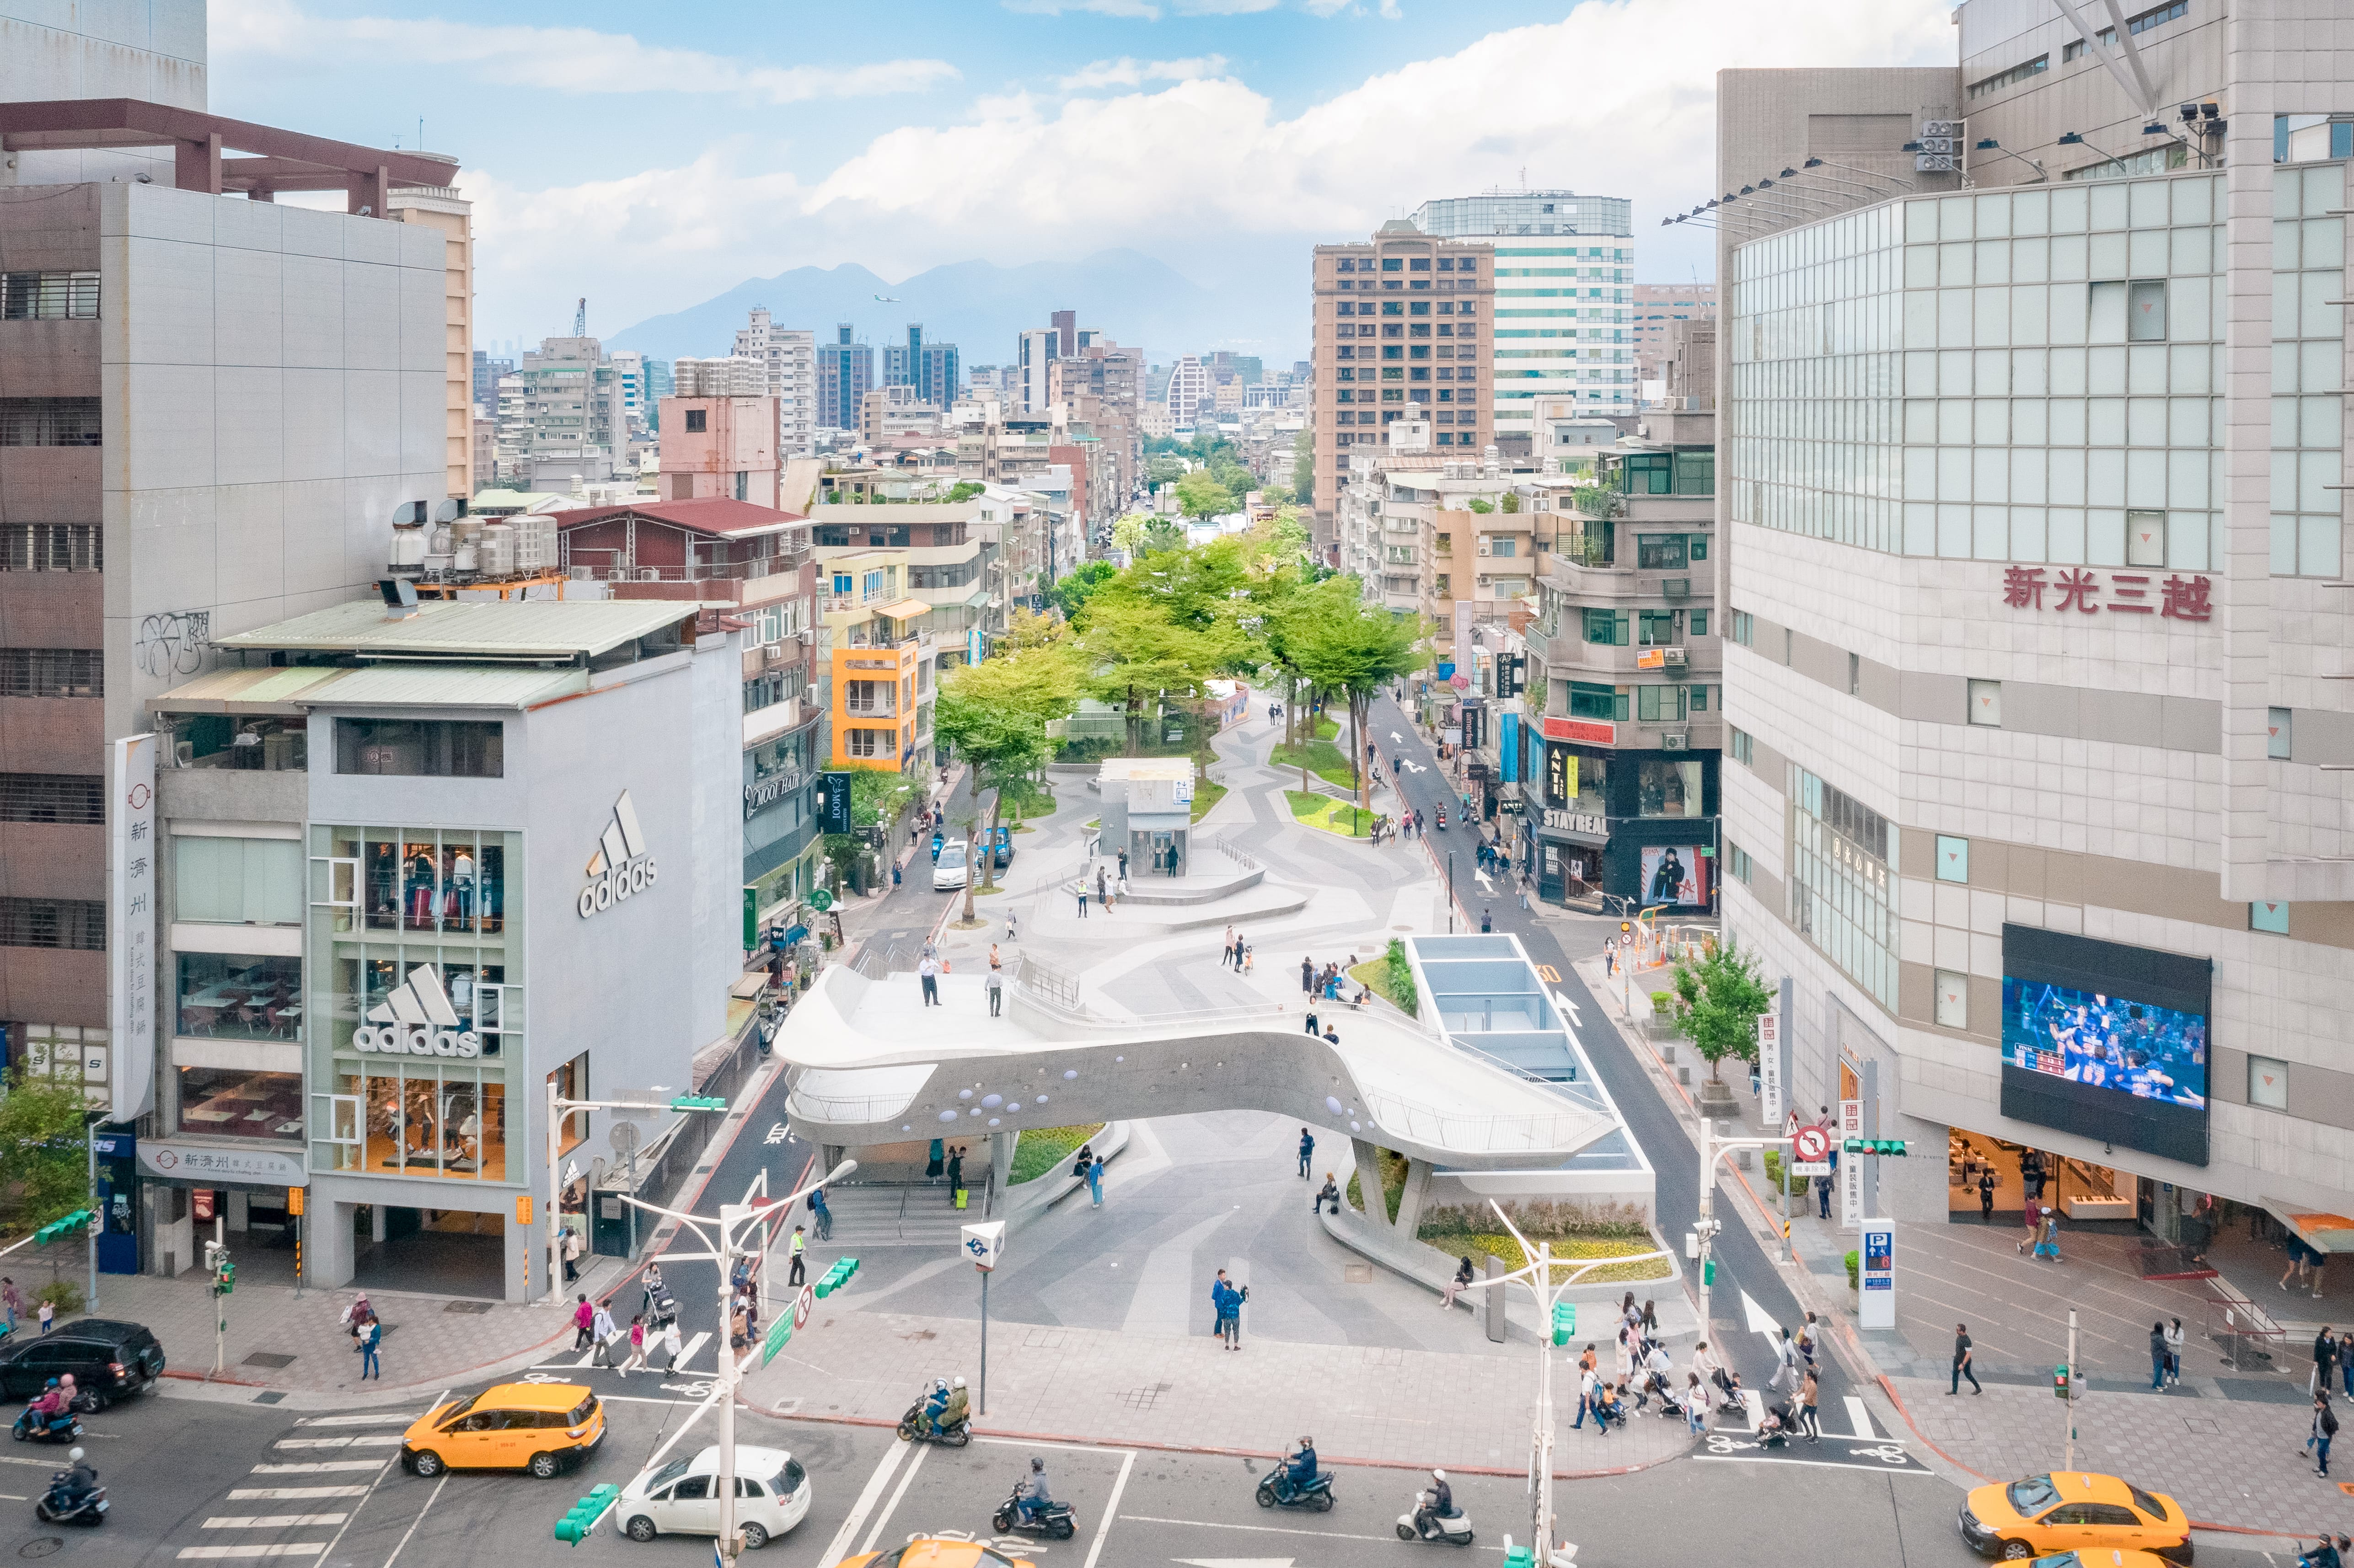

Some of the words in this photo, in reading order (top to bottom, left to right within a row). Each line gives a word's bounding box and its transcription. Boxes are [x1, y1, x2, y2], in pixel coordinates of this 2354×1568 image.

[2003, 566, 2212, 621] 新光三越
[1551, 749, 1561, 794] ANTI
[756, 783, 778, 807] MOOI
[780, 773, 800, 795] HAIR
[832, 794, 841, 819] MOOI
[1544, 809, 1610, 837] STAYREAL
[130, 821, 147, 916] 新濟州
[578, 855, 658, 918] adidas
[353, 1020, 479, 1058] adidas
[185, 1153, 228, 1168] 新濟州
[562, 1171, 580, 1188] adidas
[1873, 1236, 1884, 1244] P
